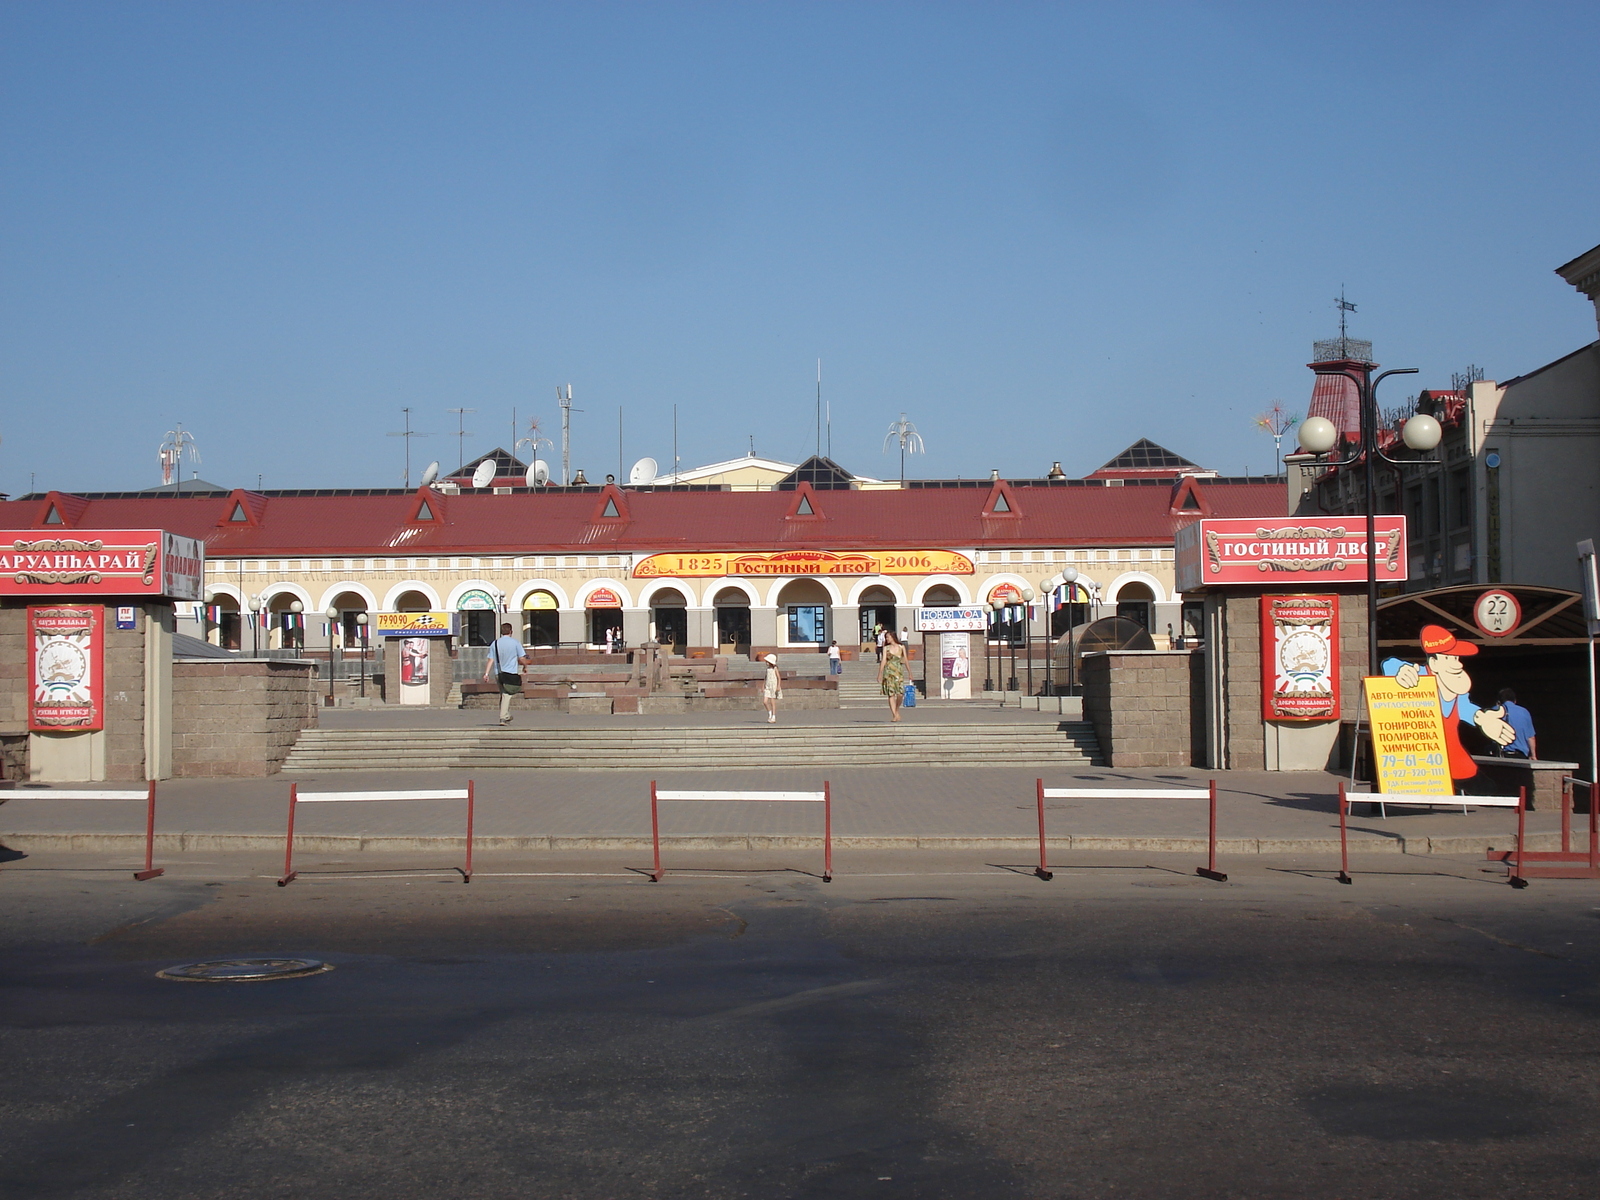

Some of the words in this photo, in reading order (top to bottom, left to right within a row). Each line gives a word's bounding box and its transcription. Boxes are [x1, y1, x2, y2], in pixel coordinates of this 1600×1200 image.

[1224, 540, 1329, 556] ГОСТИНЫЙ
[165, 553, 201, 577] BROADWAY
[676, 558, 723, 570] 1825
[885, 556, 932, 568] 2006
[379, 615, 388, 624] 79
[388, 615, 398, 624] 90
[398, 615, 408, 624] 90
[923, 610, 954, 620] НОВАЯ
[402, 621, 445, 630] Лидер
[1371, 691, 1436, 700] АВТО-ПРЕМИУМ
[1373, 700, 1436, 709] КРУГЛОСУТОЧНО
[1401, 708, 1436, 719] МОЙКА
[1378, 720, 1437, 731] ТОНИРОВКА
[1379, 731, 1439, 742] ПОЛИРОВКА
[1382, 742, 1441, 753] ХИМЧИСТКА
[1381, 753, 1443, 768] 79-61-40
[1382, 768, 1445, 778] 8-927-320-1111
